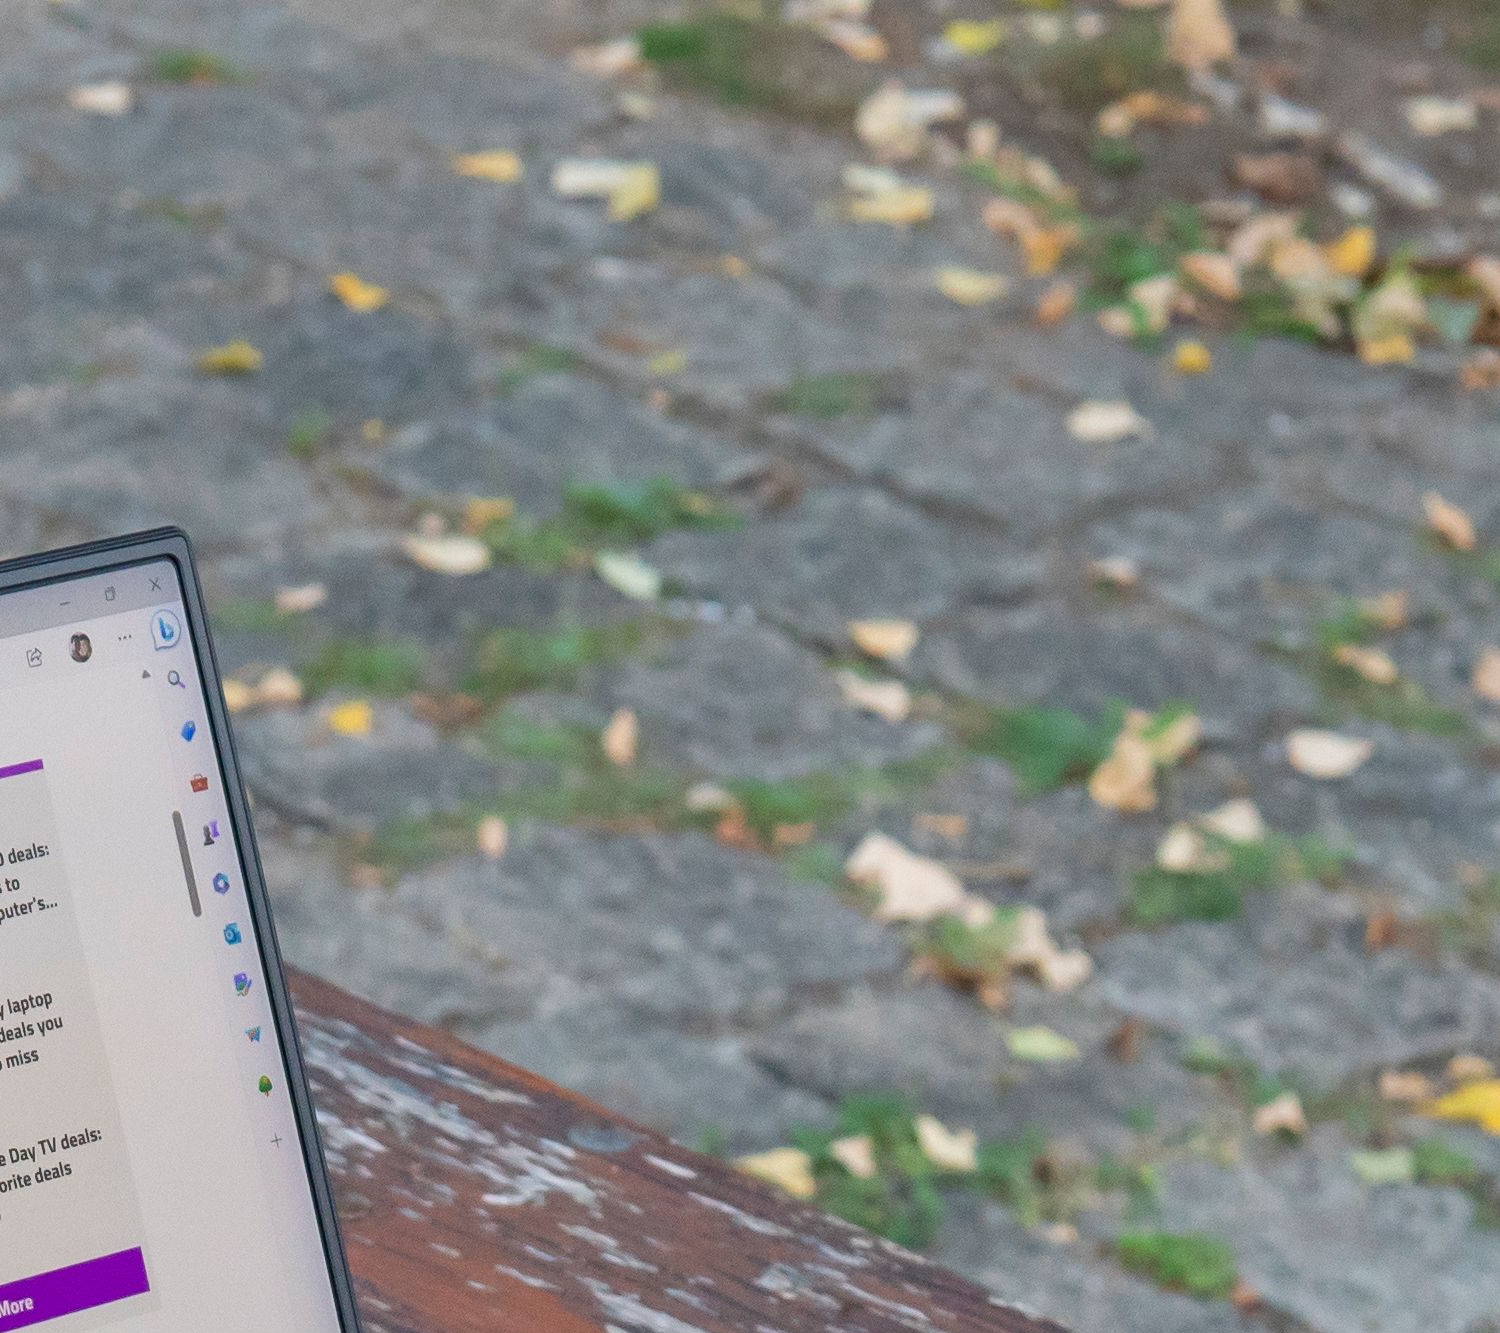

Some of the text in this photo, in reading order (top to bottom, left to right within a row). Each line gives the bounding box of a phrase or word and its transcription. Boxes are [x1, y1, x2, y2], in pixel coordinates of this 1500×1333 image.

[7, 842, 50, 865] deals:
[4, 877, 21, 892] to
[6, 992, 53, 1015] laptop
[36, 1016, 63, 1037] you
[5, 1049, 39, 1069] miss
[8, 1146, 36, 1164] Day
[37, 1136, 57, 1155] TV
[60, 1127, 102, 1150] deals:
[34, 1161, 73, 1184] deals
